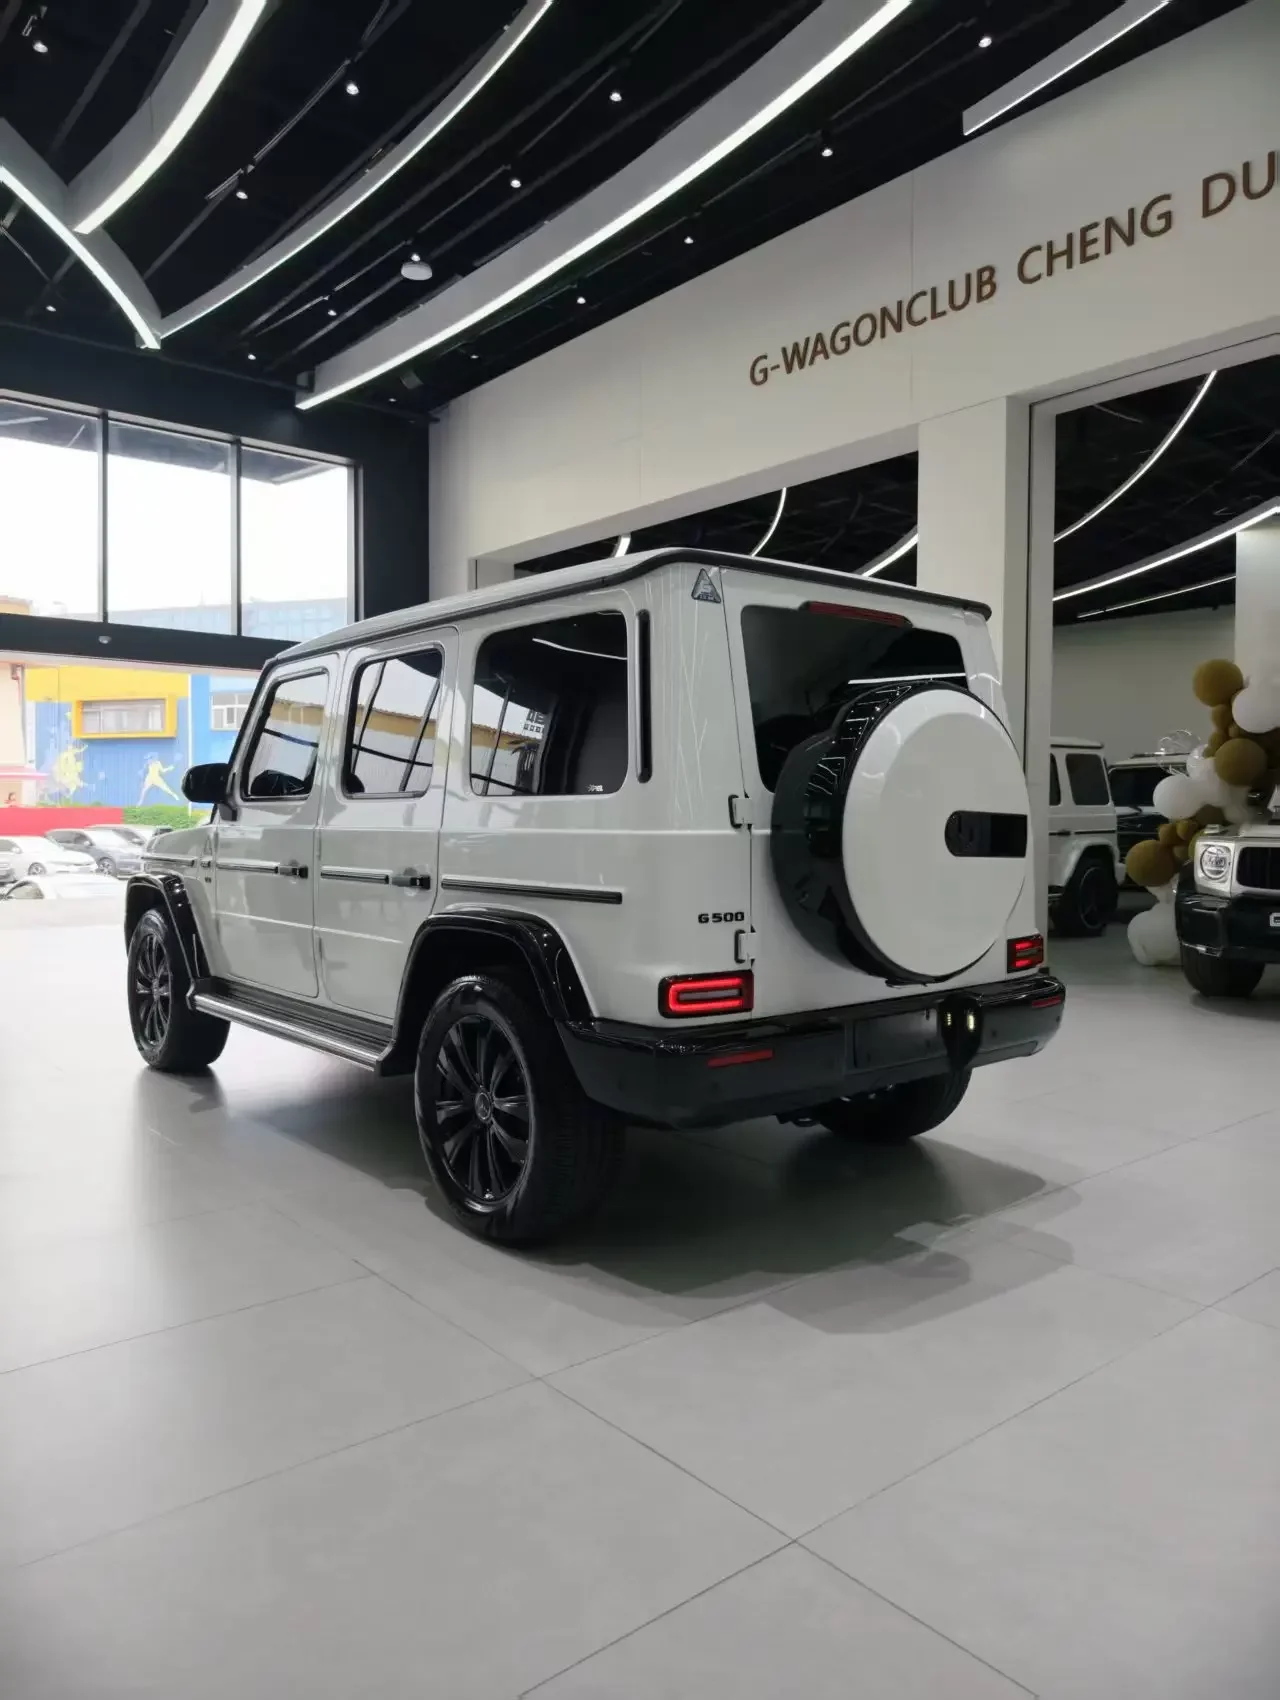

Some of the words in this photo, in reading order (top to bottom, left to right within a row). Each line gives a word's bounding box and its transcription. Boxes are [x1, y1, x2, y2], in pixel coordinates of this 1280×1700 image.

[749, 264, 997, 387] G-WAGONCLUB
[1016, 193, 1173, 285] CHENG
[1202, 150, 1276, 219] DU
[698, 913, 709, 924] G
[712, 911, 744, 923] 500
